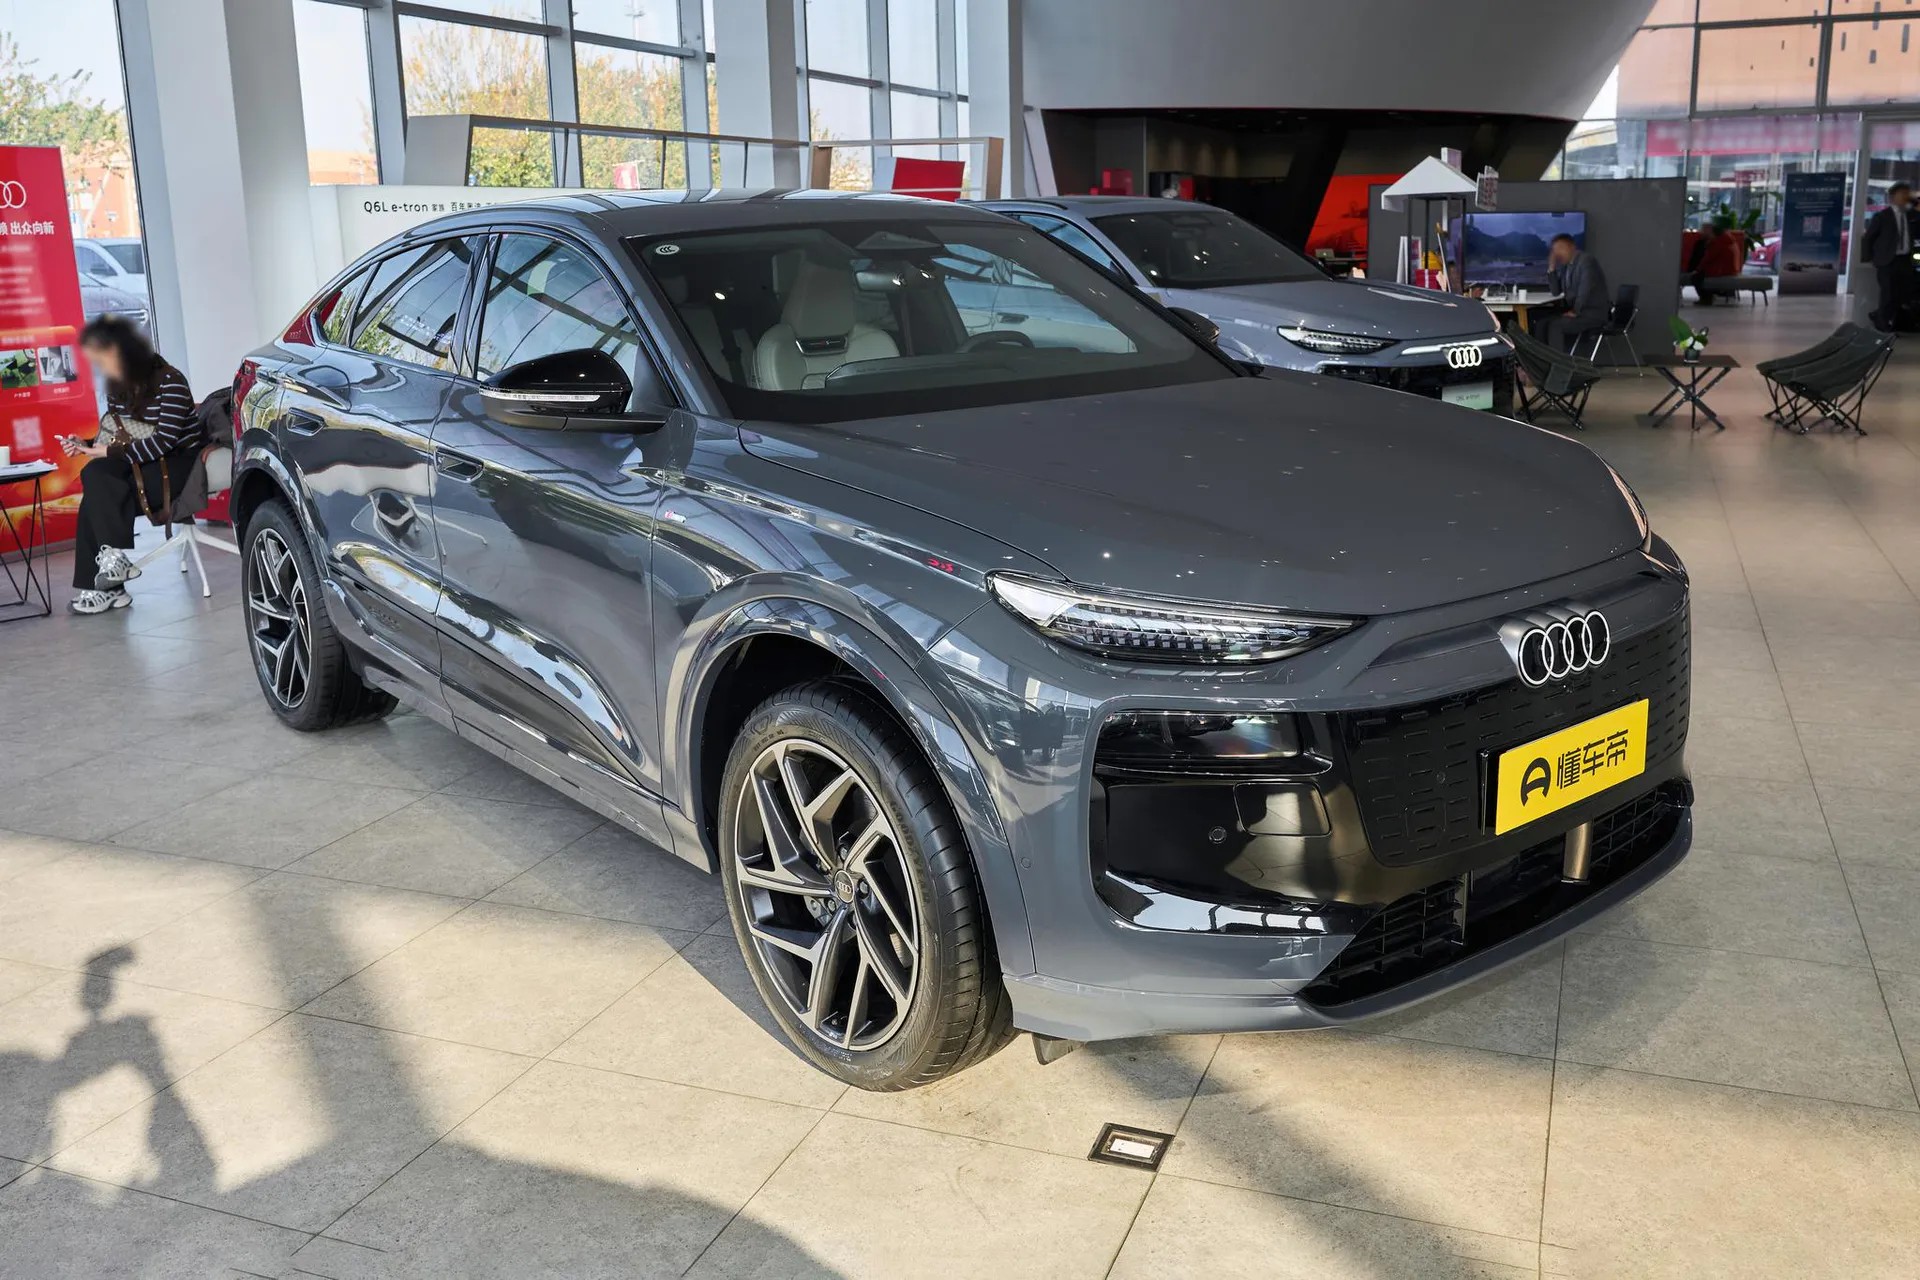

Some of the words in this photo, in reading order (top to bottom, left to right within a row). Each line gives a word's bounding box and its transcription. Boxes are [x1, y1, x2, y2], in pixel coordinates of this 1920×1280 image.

[363, 201, 388, 213] Q6L
[391, 203, 429, 212] e-tron
[10, 220, 55, 235] 出众向新
[1556, 729, 1628, 789] 懂车帝
